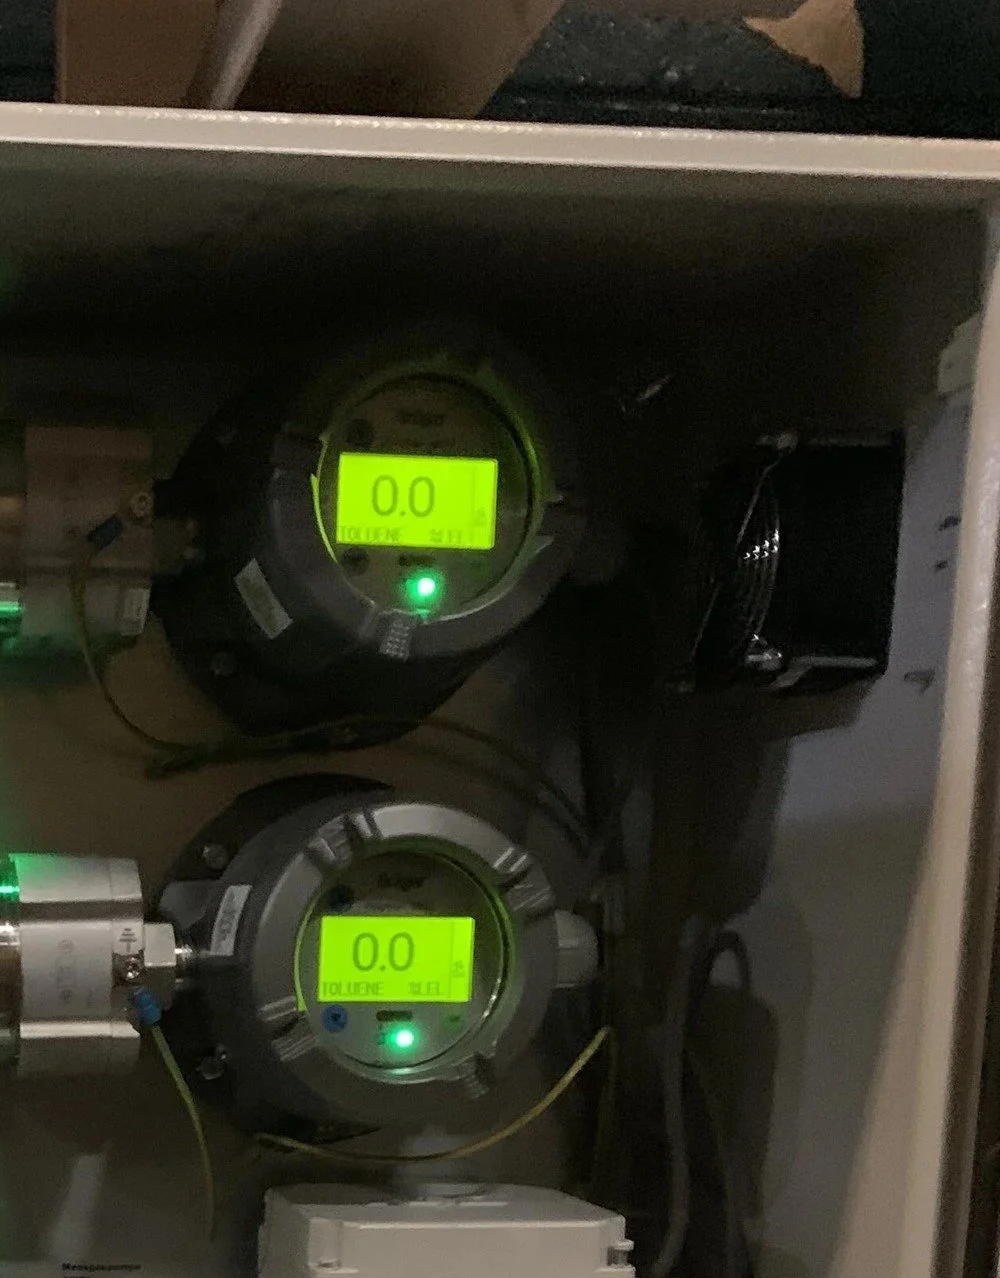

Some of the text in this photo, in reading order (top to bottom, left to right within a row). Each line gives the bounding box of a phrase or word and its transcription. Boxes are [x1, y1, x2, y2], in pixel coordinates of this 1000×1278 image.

[371, 474, 436, 518] 0.0
[352, 931, 416, 973] 0.0
[322, 981, 384, 996] TOLUENE
